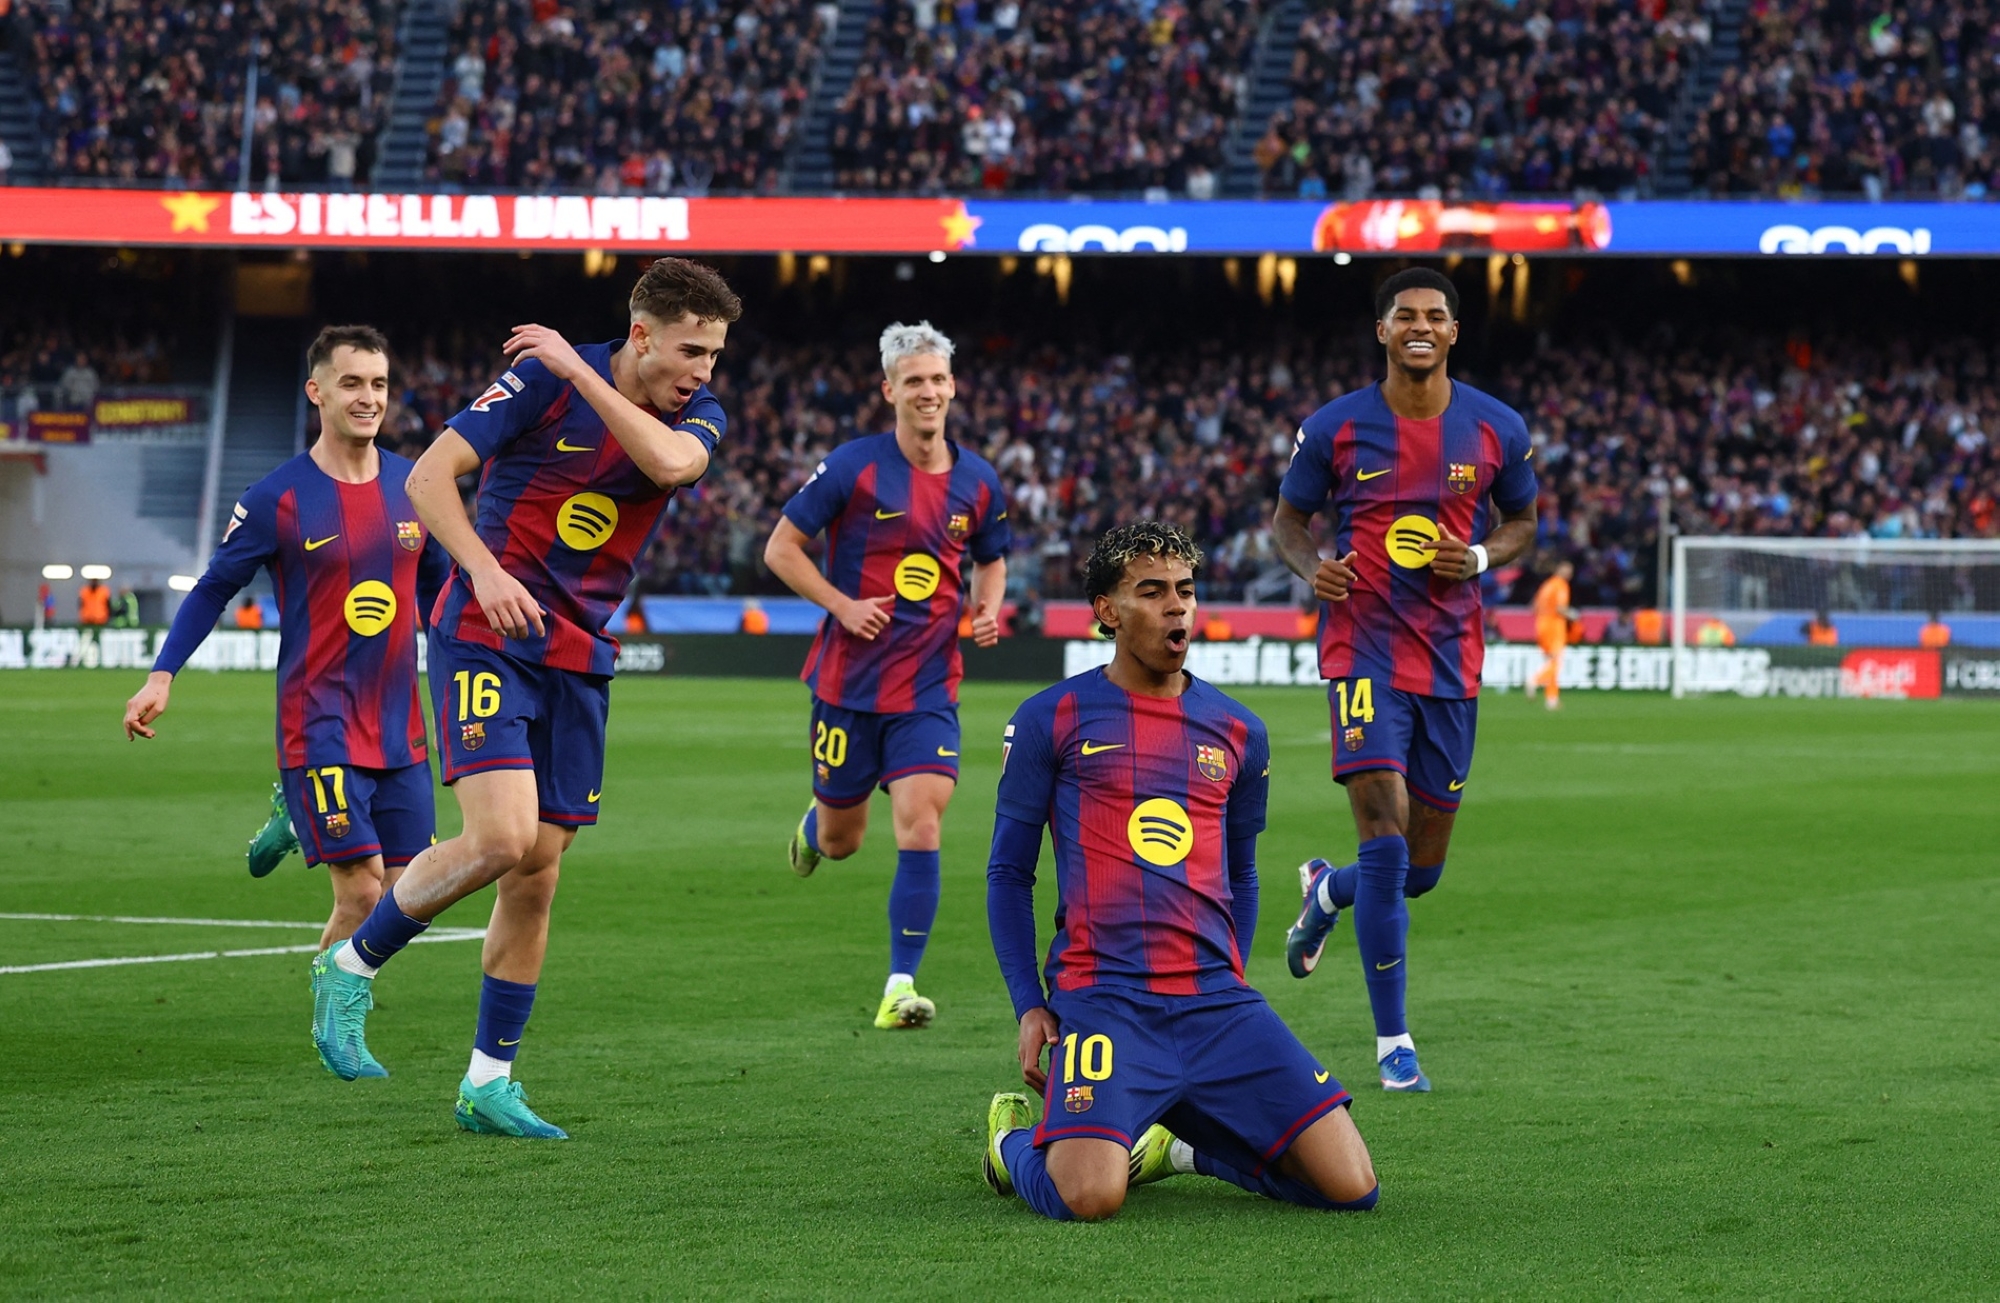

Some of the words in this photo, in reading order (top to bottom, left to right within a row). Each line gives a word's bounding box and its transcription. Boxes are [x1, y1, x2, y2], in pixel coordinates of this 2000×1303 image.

[230, 192, 500, 237] ESTRELLA
[454, 670, 501, 721] 16
[1336, 678, 1375, 727] 14
[814, 720, 848, 767] 20
[306, 766, 348, 813] 17
[1062, 1033, 1113, 1084] 10
